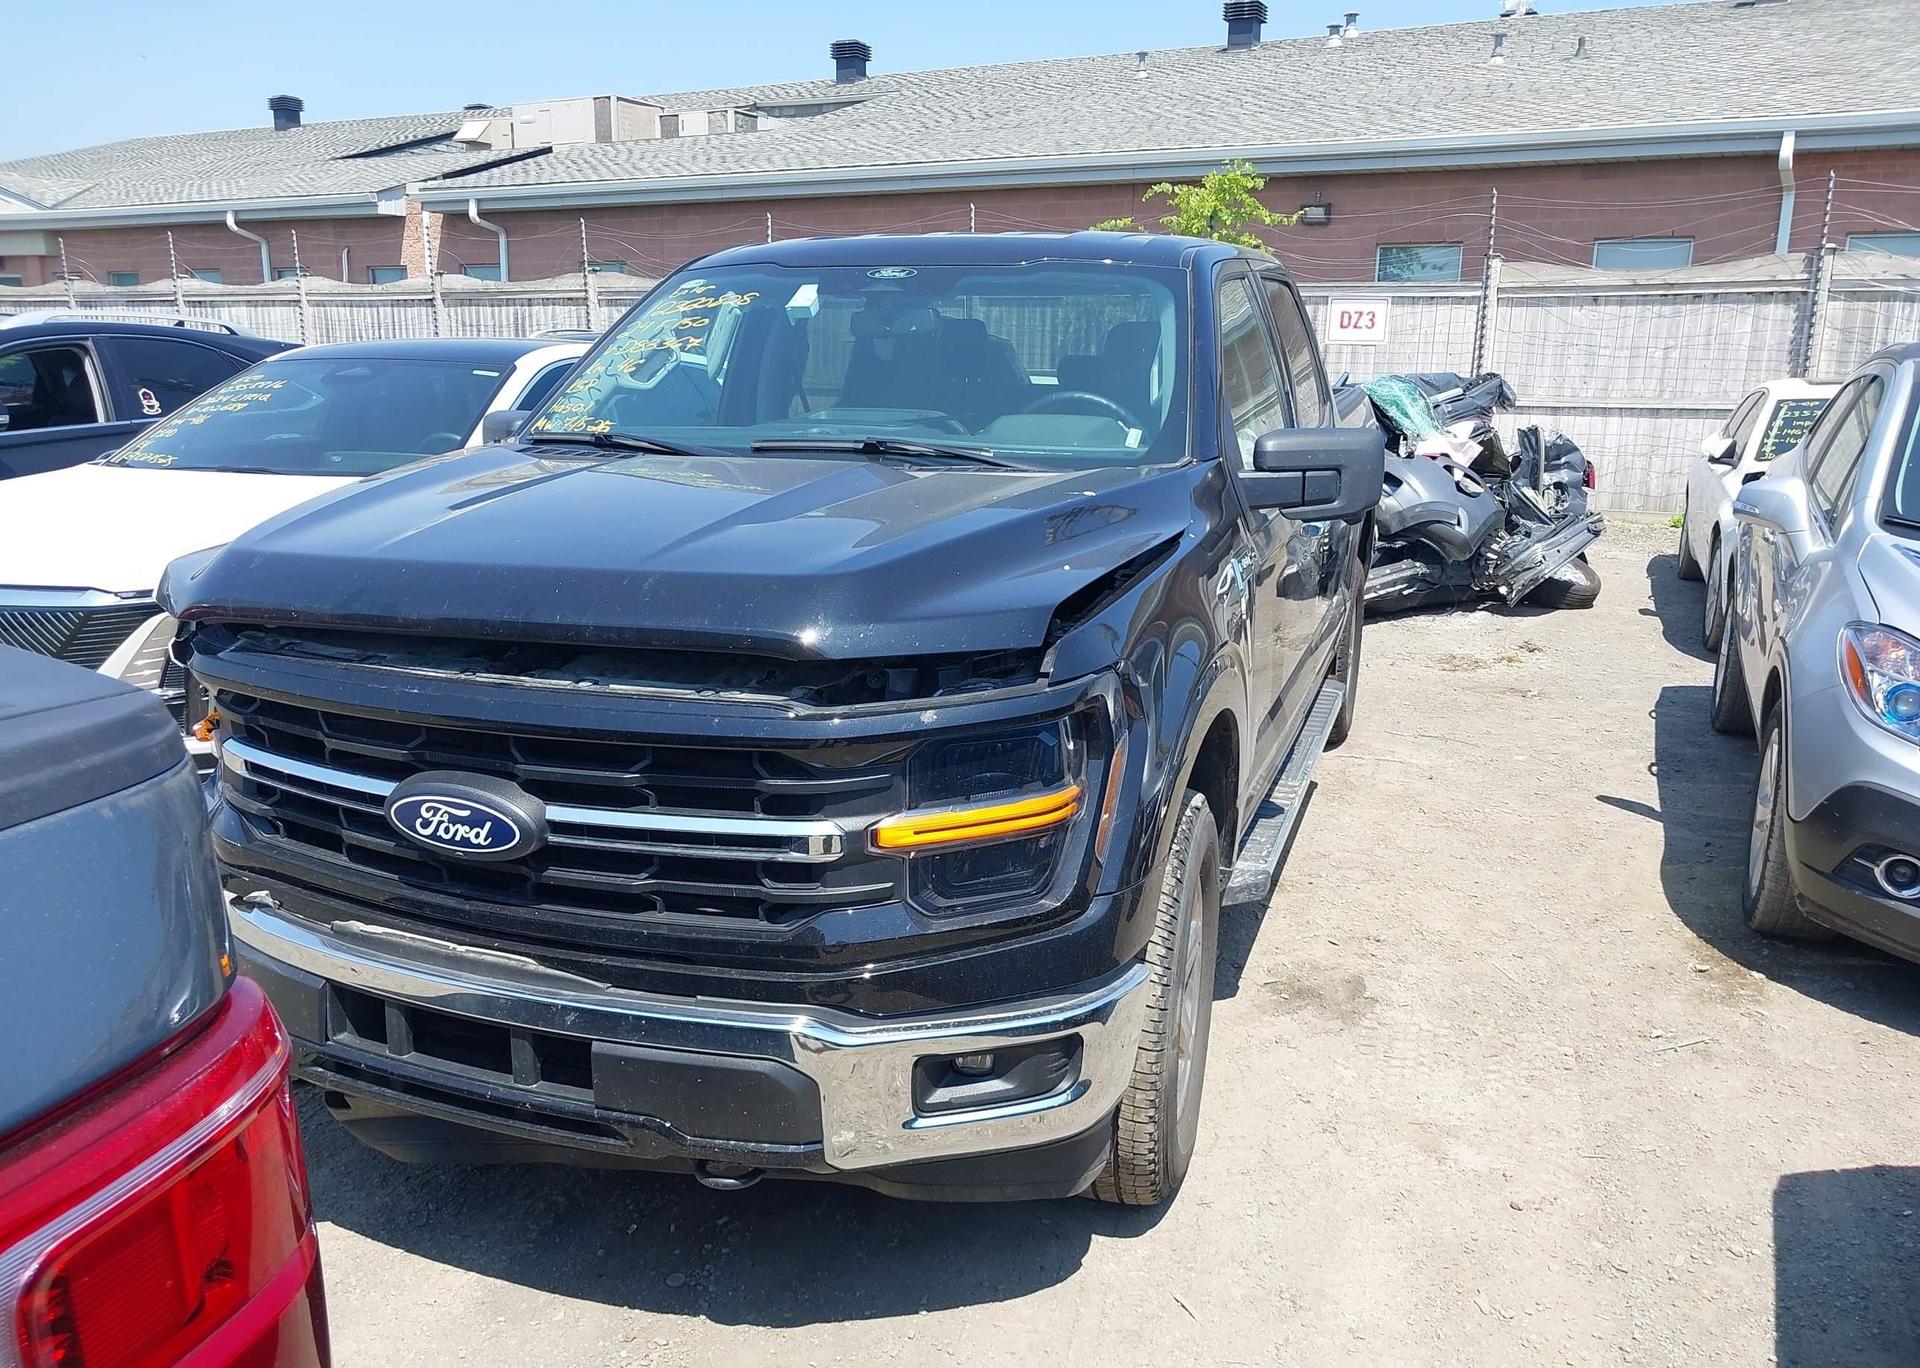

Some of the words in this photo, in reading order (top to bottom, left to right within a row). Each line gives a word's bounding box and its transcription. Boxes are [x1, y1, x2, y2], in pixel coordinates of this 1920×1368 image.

[875, 269, 909, 277] Ford
[1339, 310, 1376, 330] DZ3
[415, 802, 492, 846] Ford
